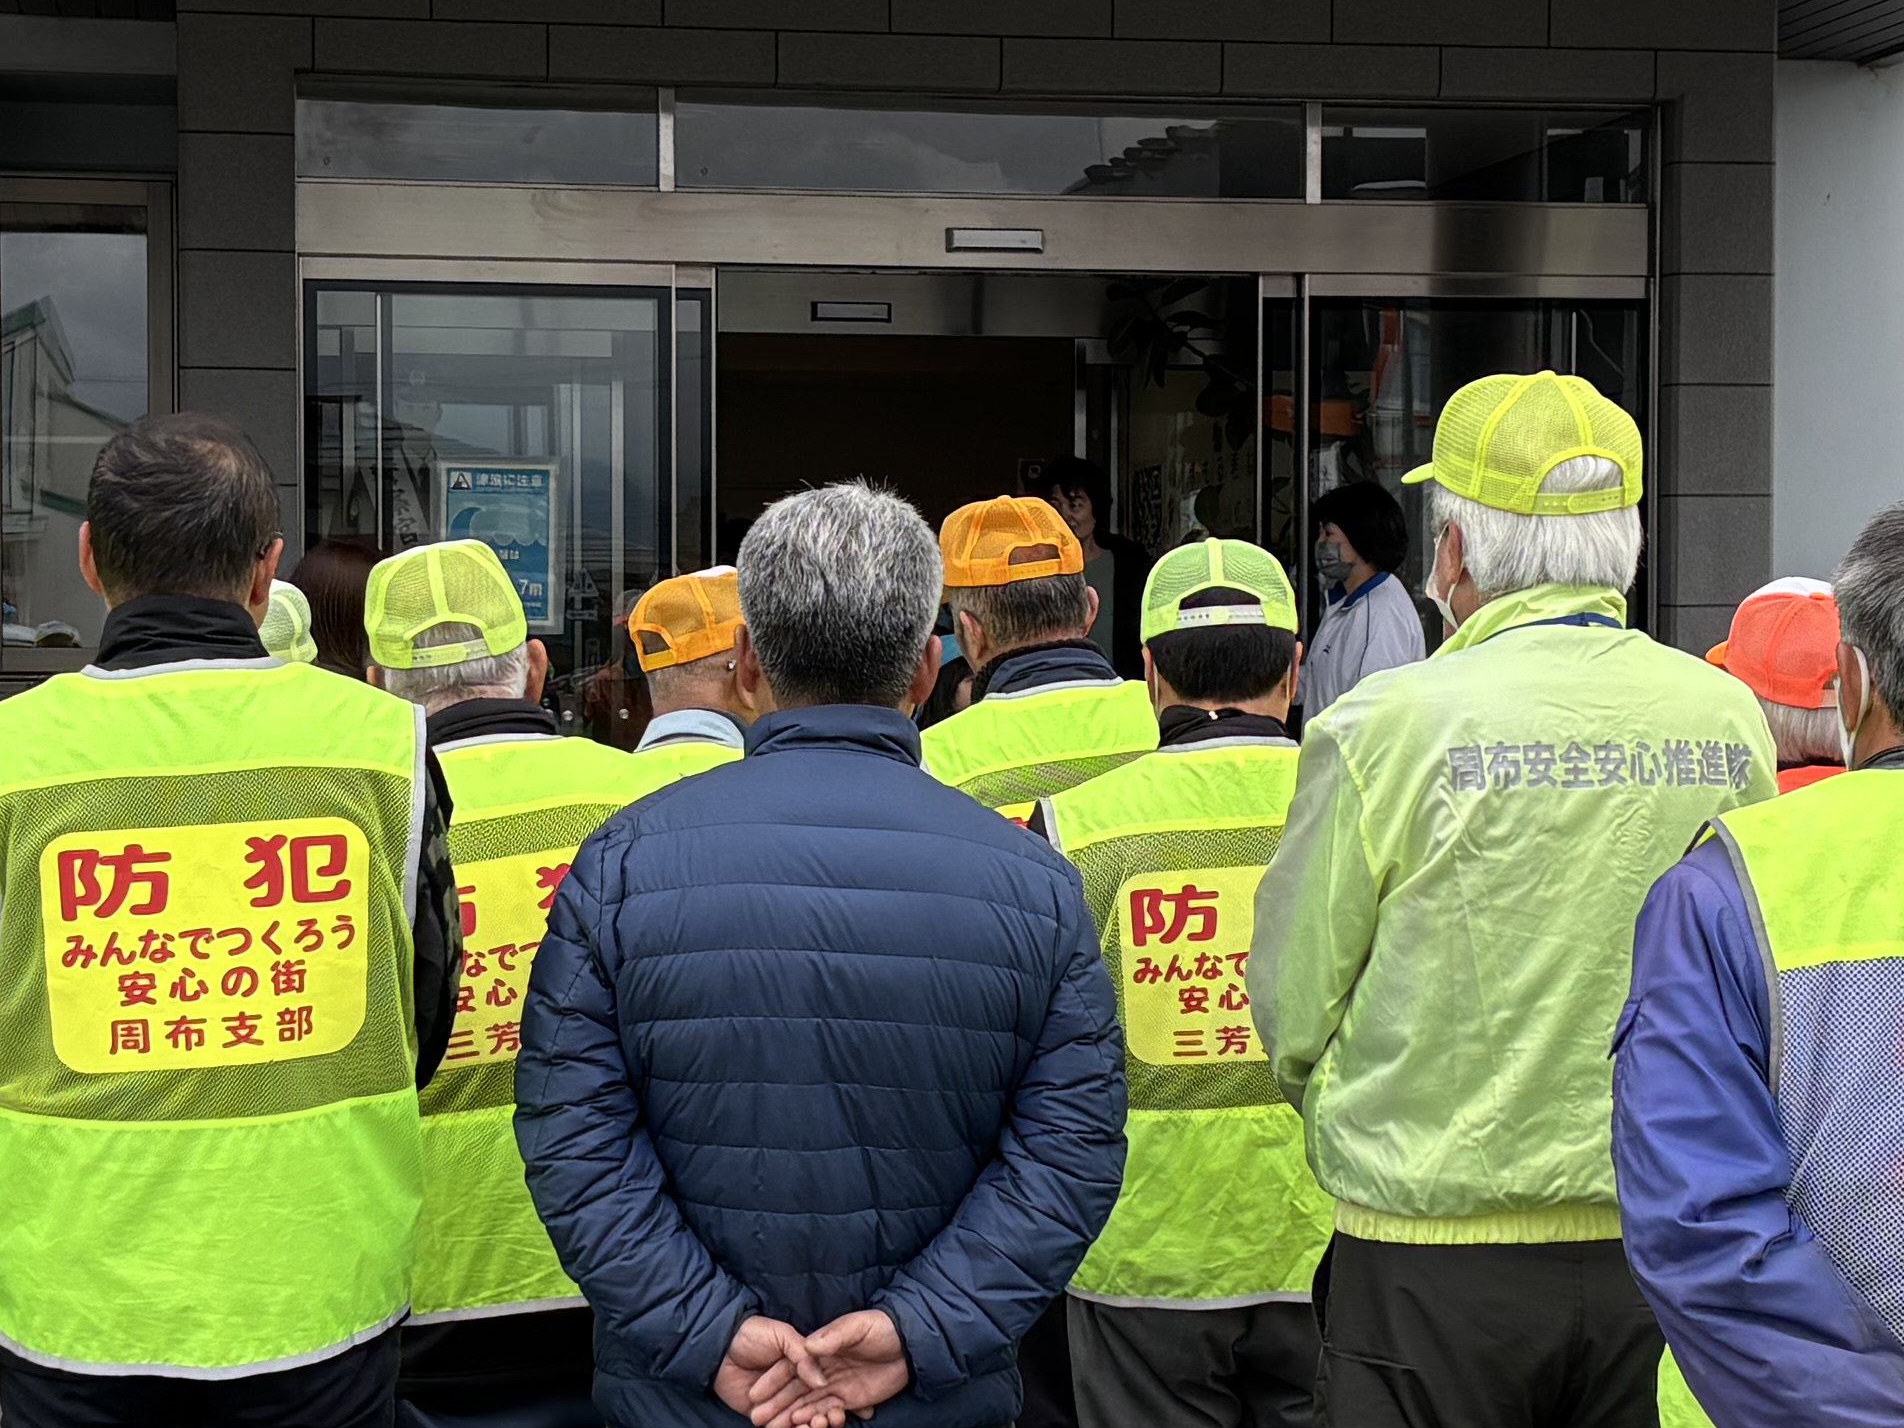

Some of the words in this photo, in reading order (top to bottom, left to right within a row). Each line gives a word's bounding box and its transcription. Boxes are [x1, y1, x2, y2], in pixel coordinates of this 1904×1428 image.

[1447, 738, 1752, 792] 周布安全安心推進隊
[58, 834, 351, 921] 防犯
[61, 915, 356, 968] みんなでつくろう
[1130, 884, 1219, 946] 防
[118, 960, 307, 1006] 安心の街
[1178, 983, 1250, 1014] 安心
[109, 1006, 314, 1055] 周布支部
